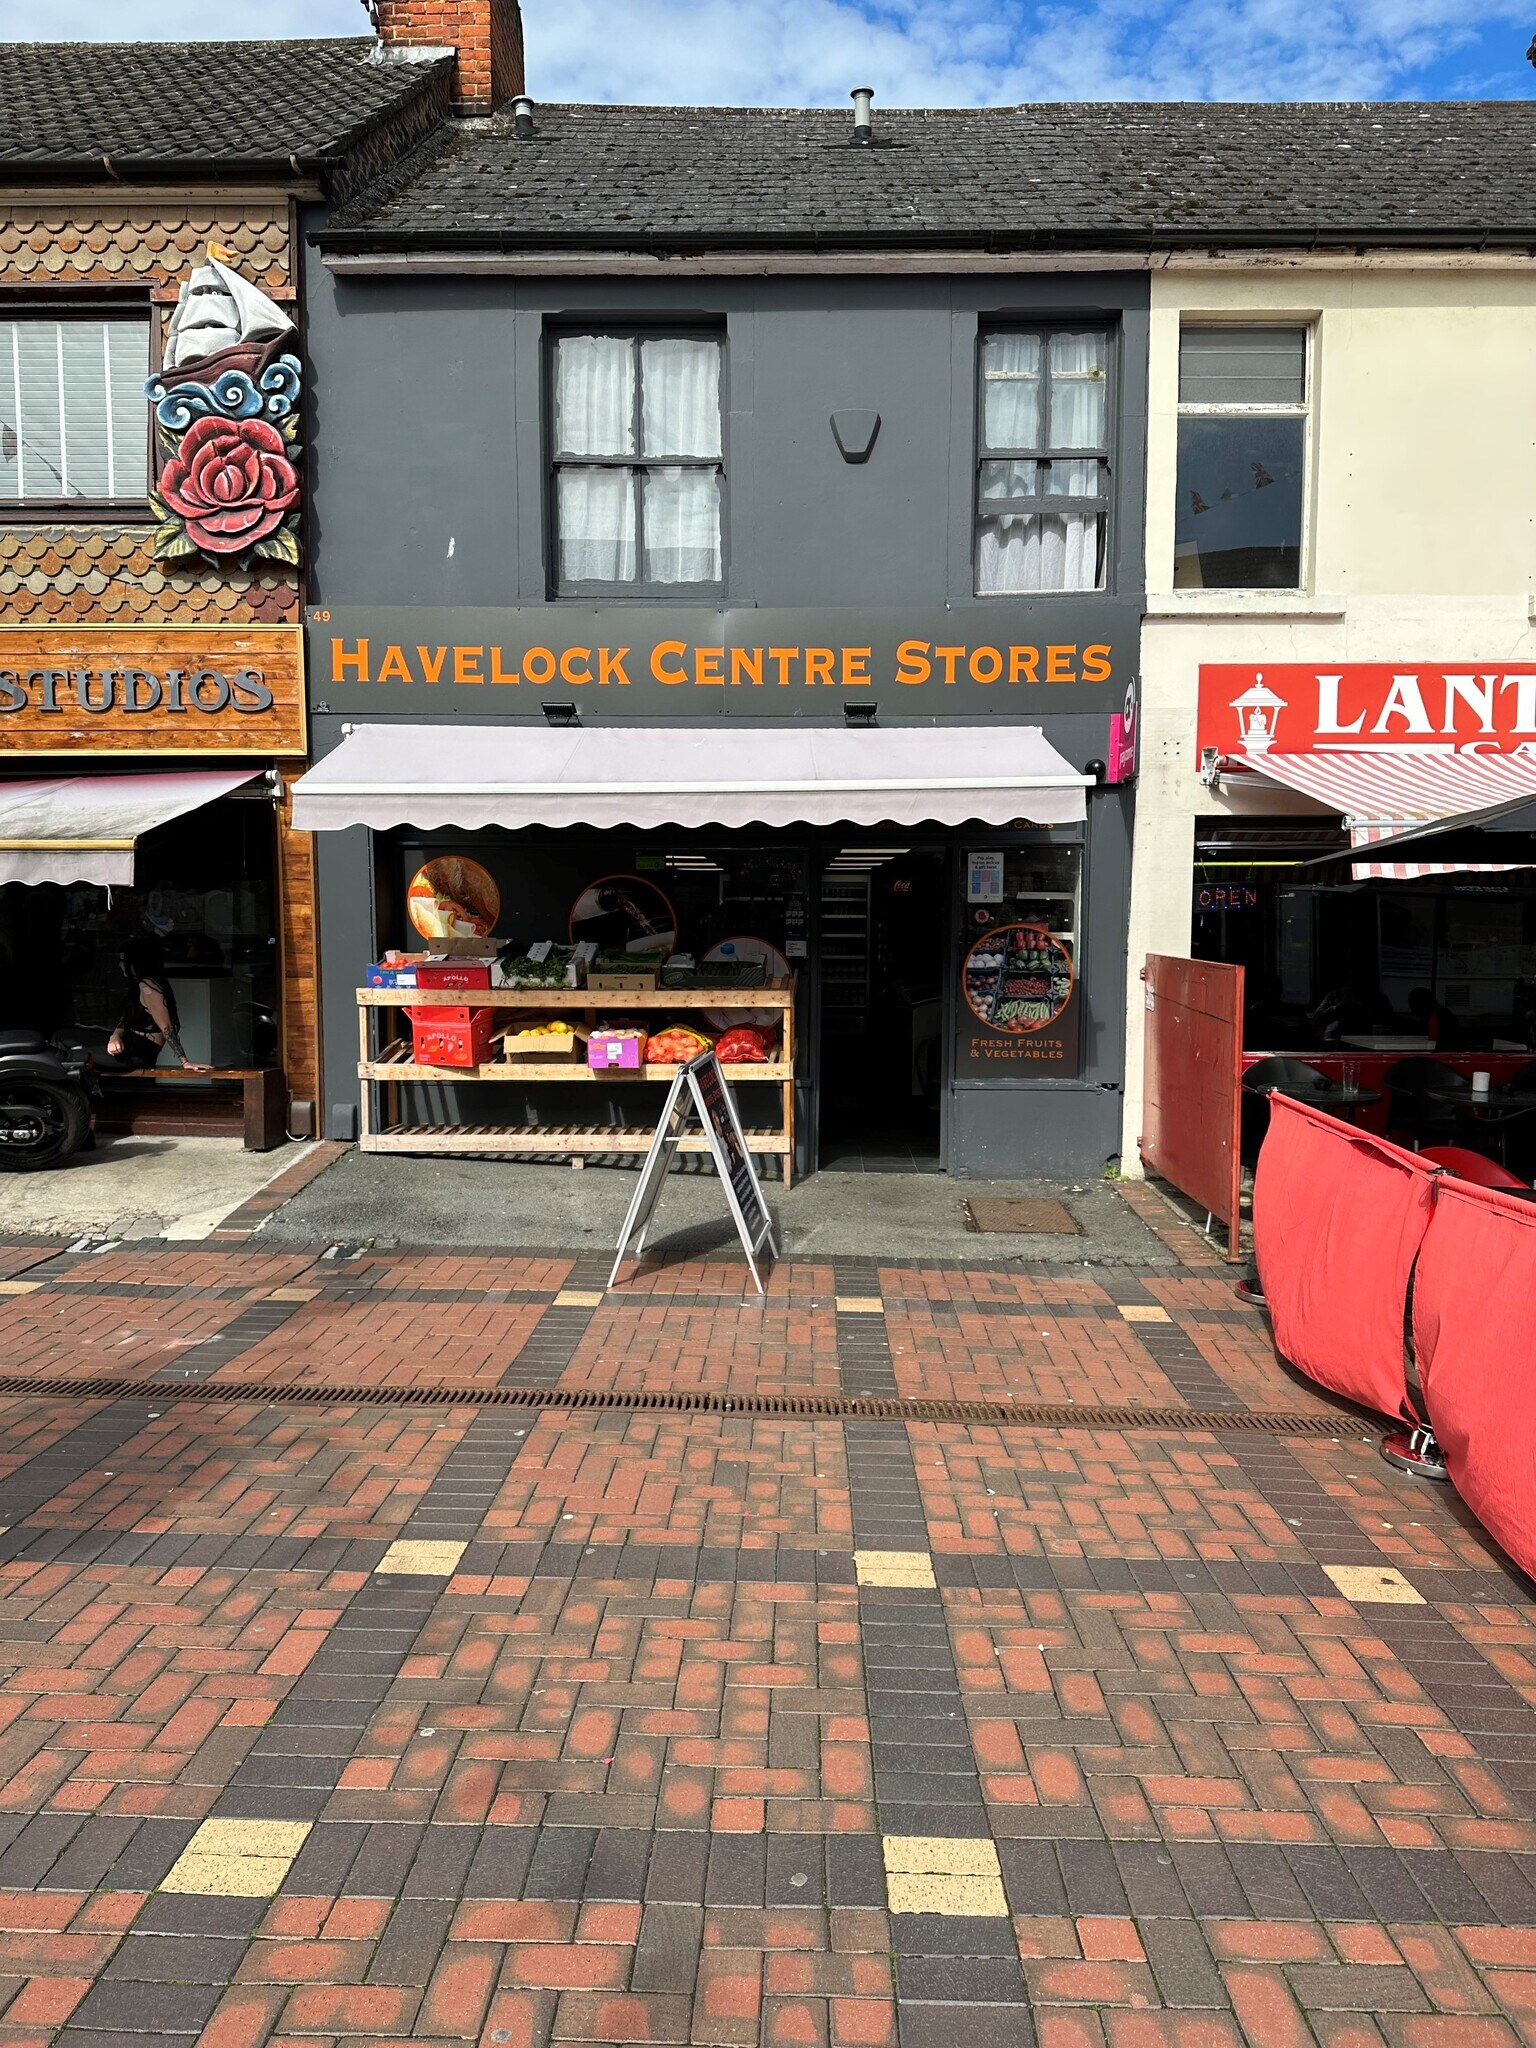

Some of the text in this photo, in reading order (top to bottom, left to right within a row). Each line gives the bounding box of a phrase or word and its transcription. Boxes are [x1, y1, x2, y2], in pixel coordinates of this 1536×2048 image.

[313, 610, 331, 622] 49
[331, 637, 1113, 686] HAVELOCK CENTRE STORES
[1199, 889, 1257, 906] OPEN
[443, 974, 469, 982] APOLLO
[426, 1031, 457, 1042] APOLLO
[971, 1038, 1063, 1048] FRESH FRUITS
[970, 1049, 1064, 1059] & VEGETABLES
